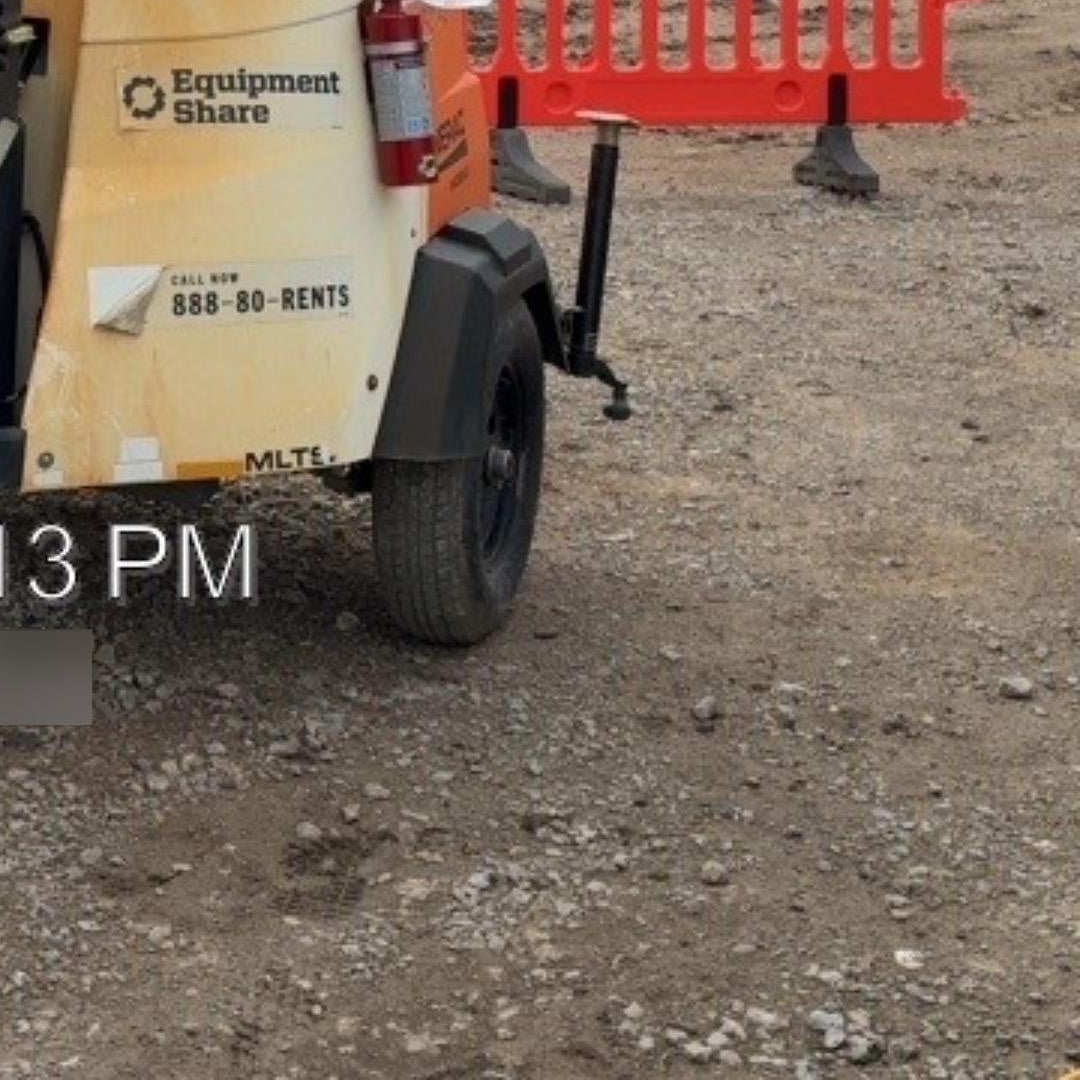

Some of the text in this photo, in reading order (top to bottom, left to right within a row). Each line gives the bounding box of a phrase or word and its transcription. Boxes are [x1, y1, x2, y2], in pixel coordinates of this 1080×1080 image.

[171, 69, 340, 99] Equipment
[173, 99, 270, 124] Share
[171, 272, 239, 286] CALL NOW
[172, 284, 350, 317] 888-80-RENTS
